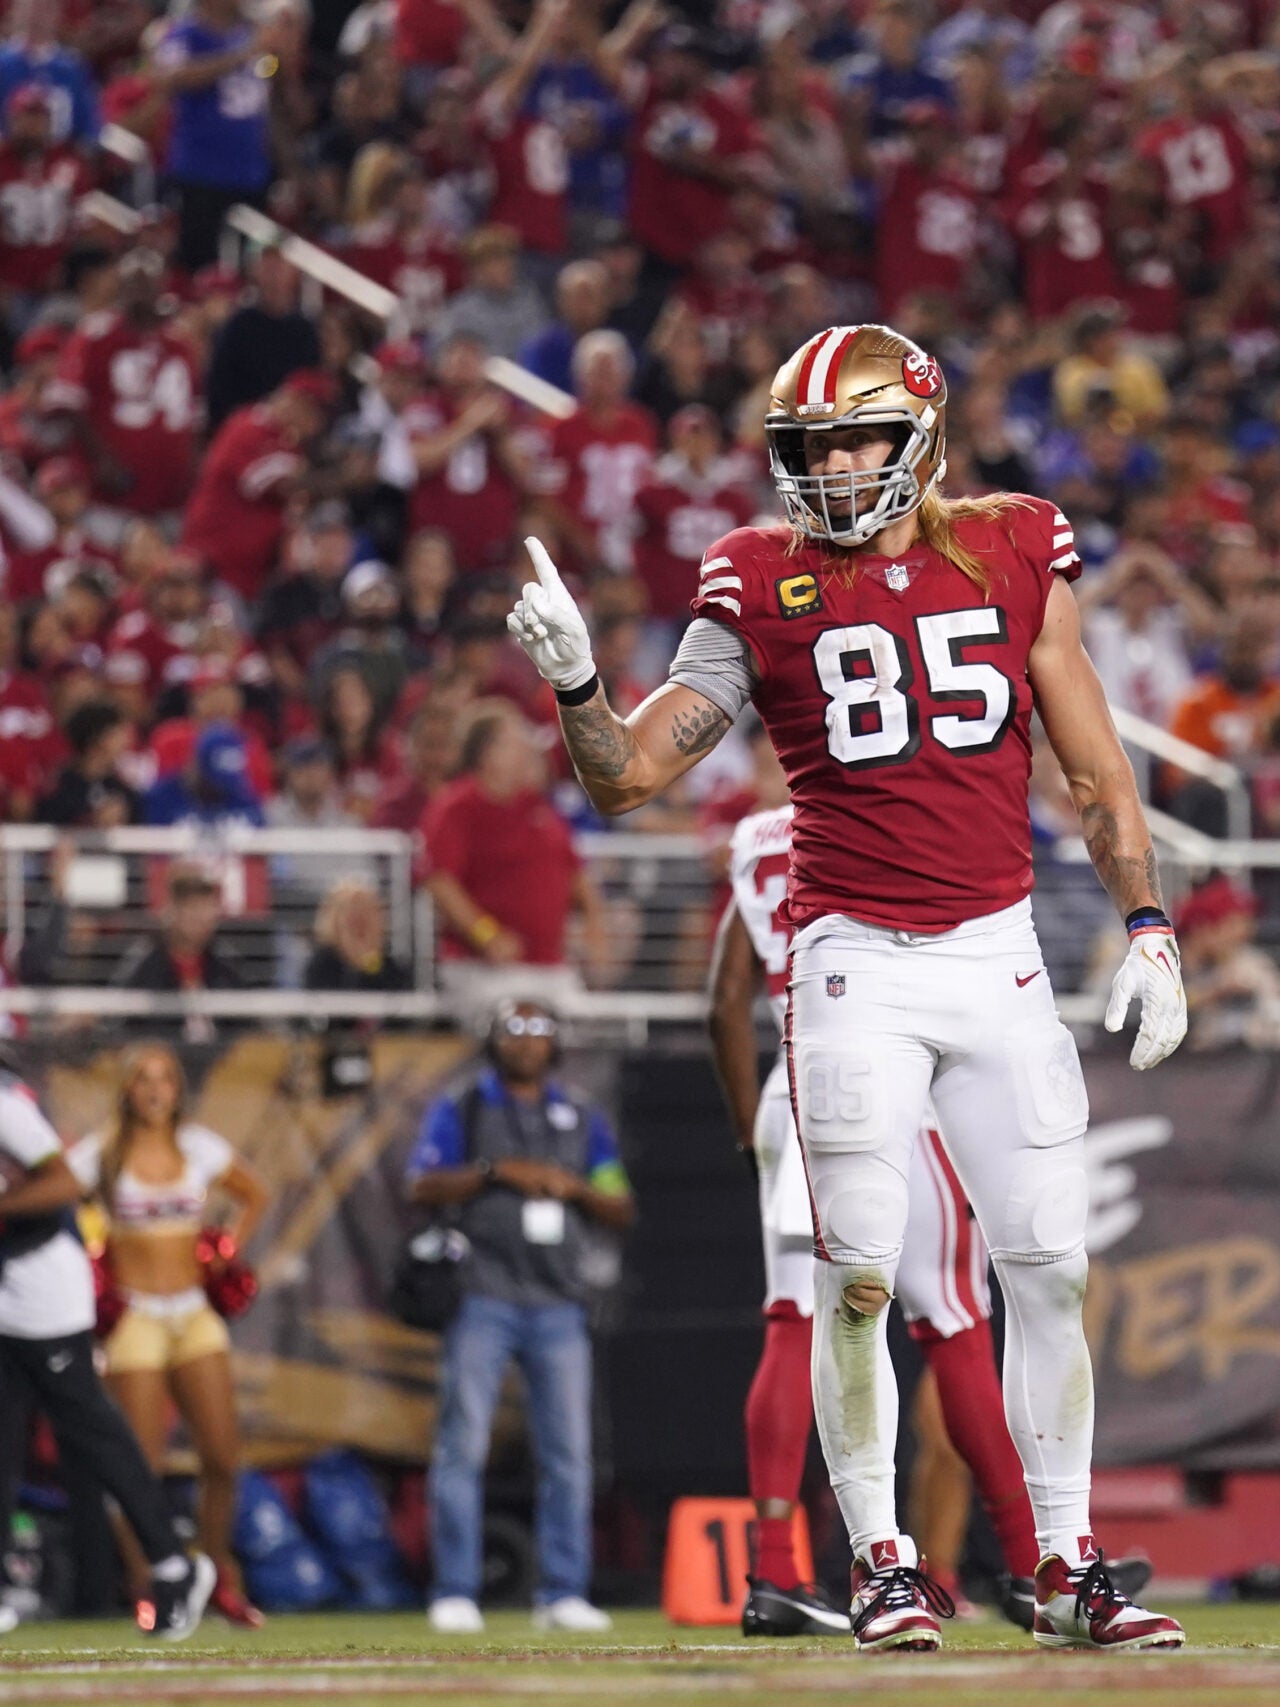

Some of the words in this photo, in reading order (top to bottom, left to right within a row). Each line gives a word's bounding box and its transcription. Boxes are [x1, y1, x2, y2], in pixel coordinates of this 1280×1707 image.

[779, 574, 818, 608] C
[812, 606, 1020, 771] 85
[806, 1062, 873, 1122] 85
